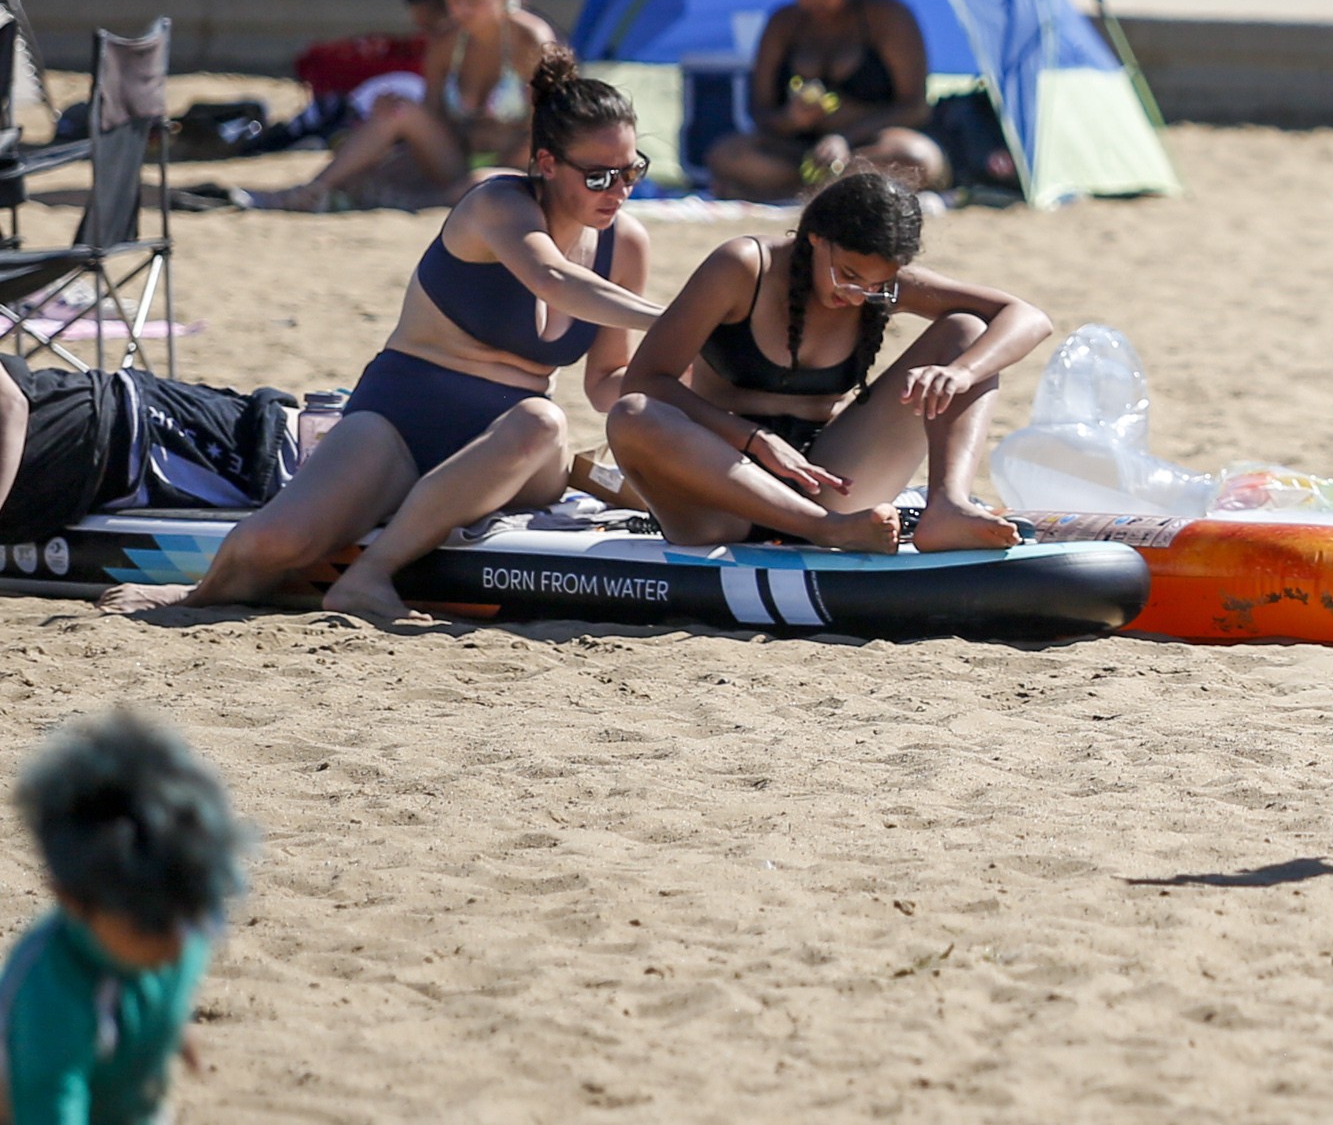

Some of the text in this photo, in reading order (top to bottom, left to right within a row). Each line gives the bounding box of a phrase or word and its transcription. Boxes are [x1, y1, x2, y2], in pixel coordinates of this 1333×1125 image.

[482, 567, 669, 602] BORN FROM WATER
